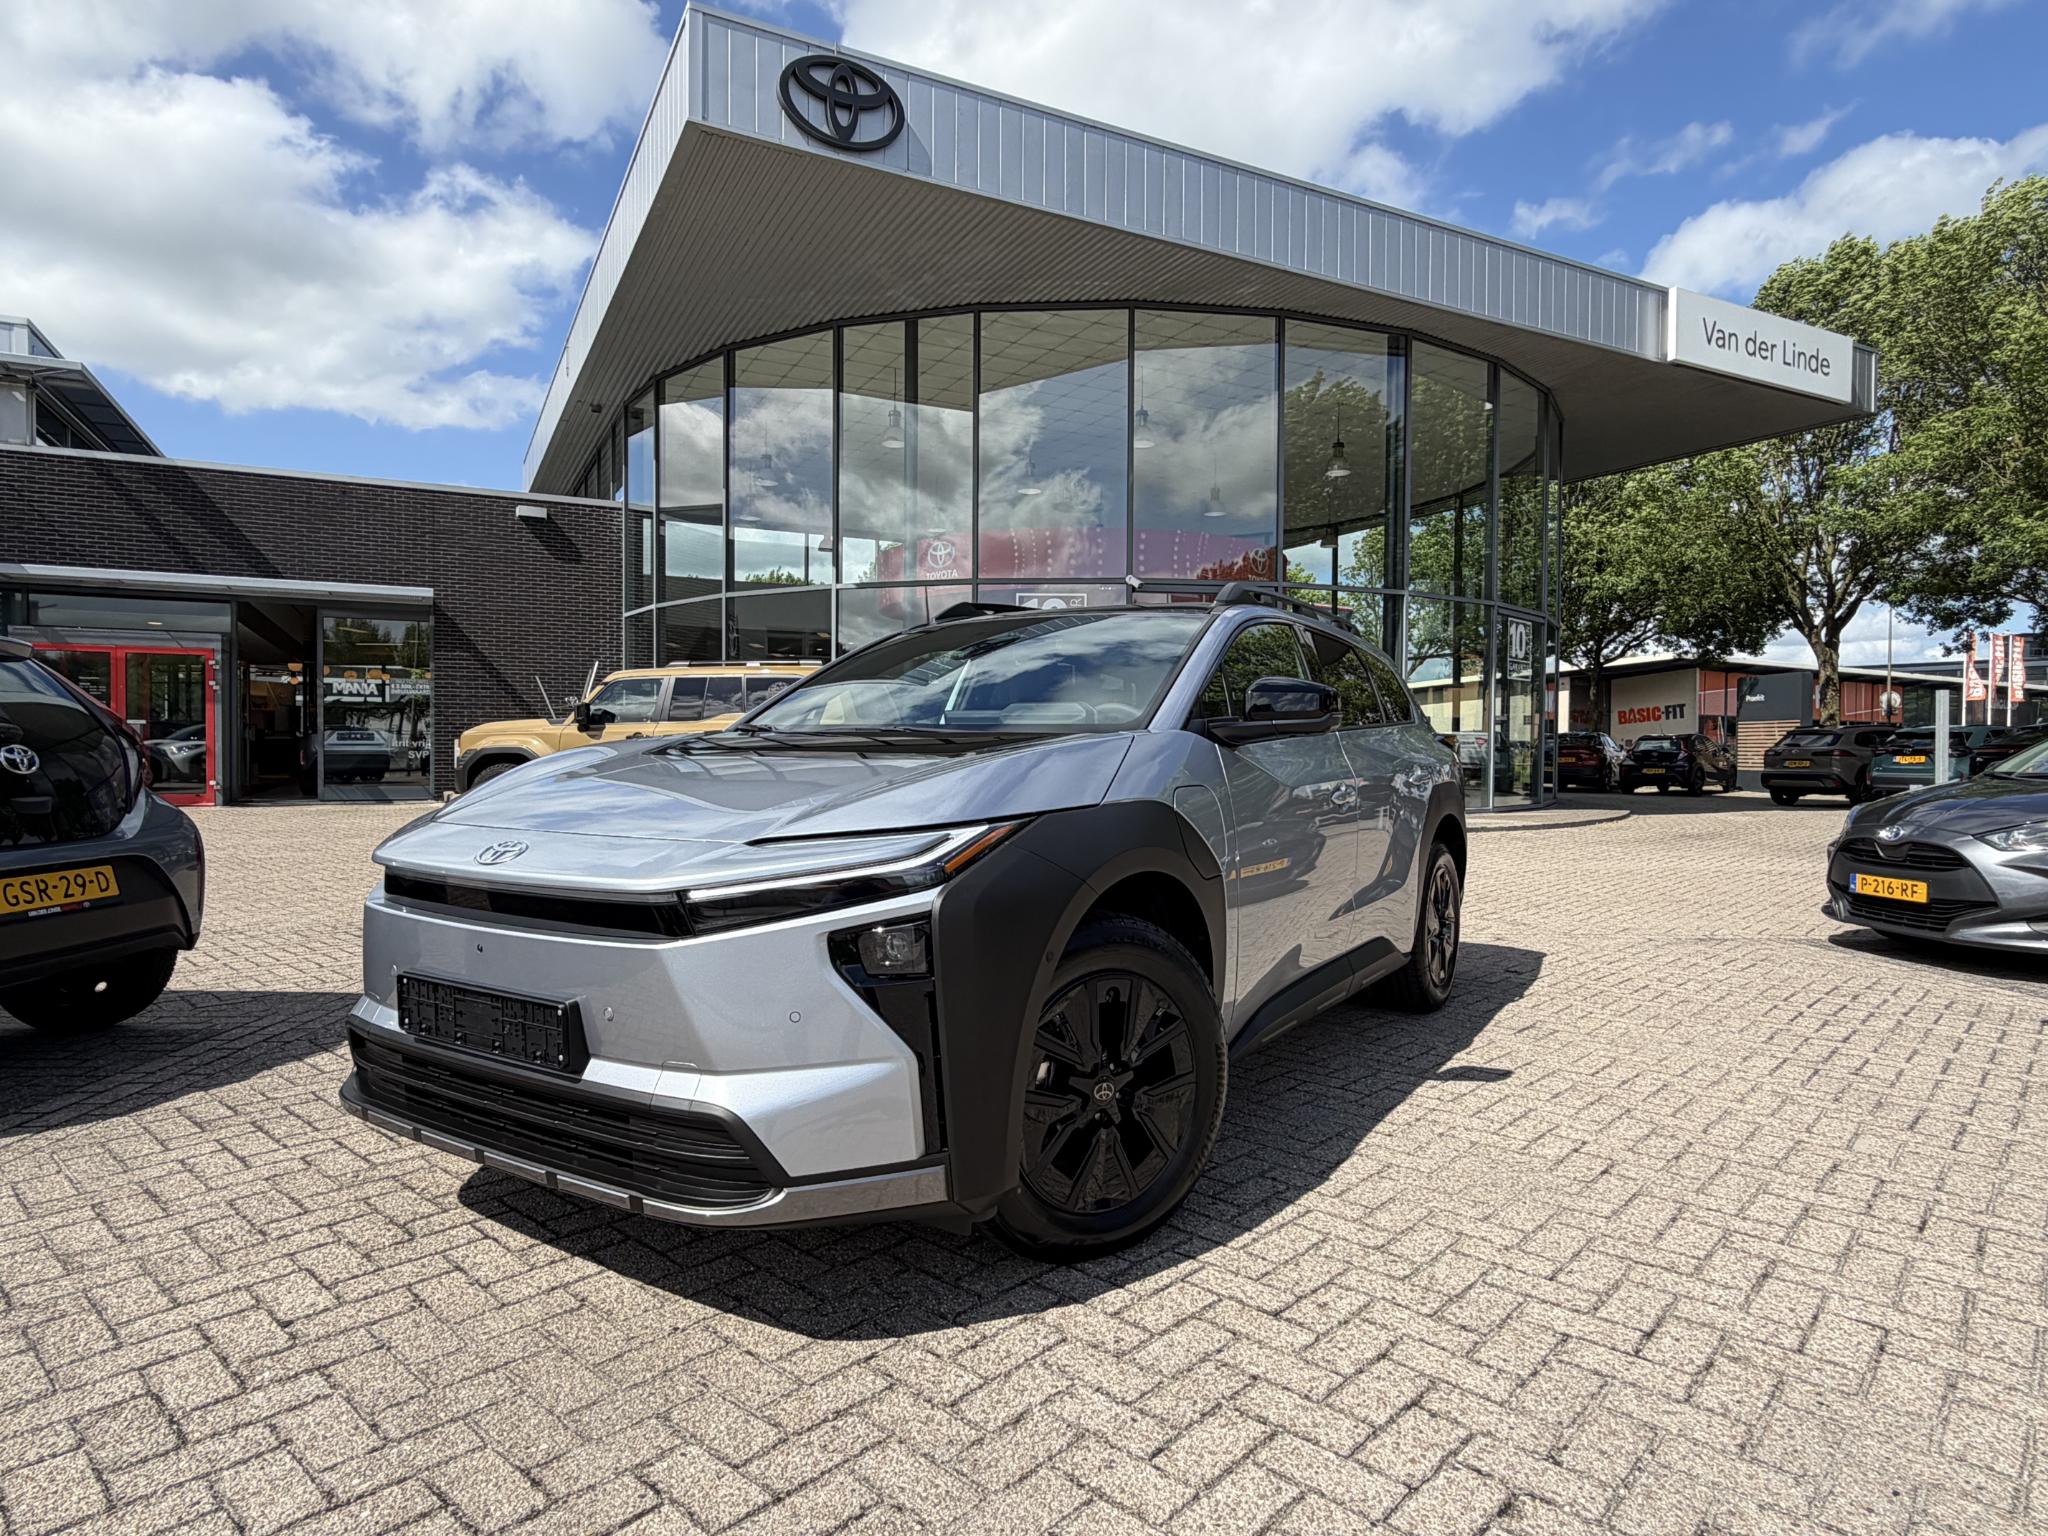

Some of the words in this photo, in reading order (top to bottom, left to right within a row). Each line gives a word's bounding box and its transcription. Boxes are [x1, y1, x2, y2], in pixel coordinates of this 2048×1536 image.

[1703, 317, 1738, 353] Van
[1745, 330, 1777, 362] der
[1783, 340, 1831, 377] Linde
[926, 569, 959, 580] TOYOTA
[1510, 623, 1526, 659] 10
[332, 682, 379, 696] MANIA
[1617, 703, 1687, 725] BASIC-FIT
[408, 750, 430, 759] SVP
[3, 870, 110, 908] GSR-29-D
[1861, 877, 1919, 898] P-216-RF
